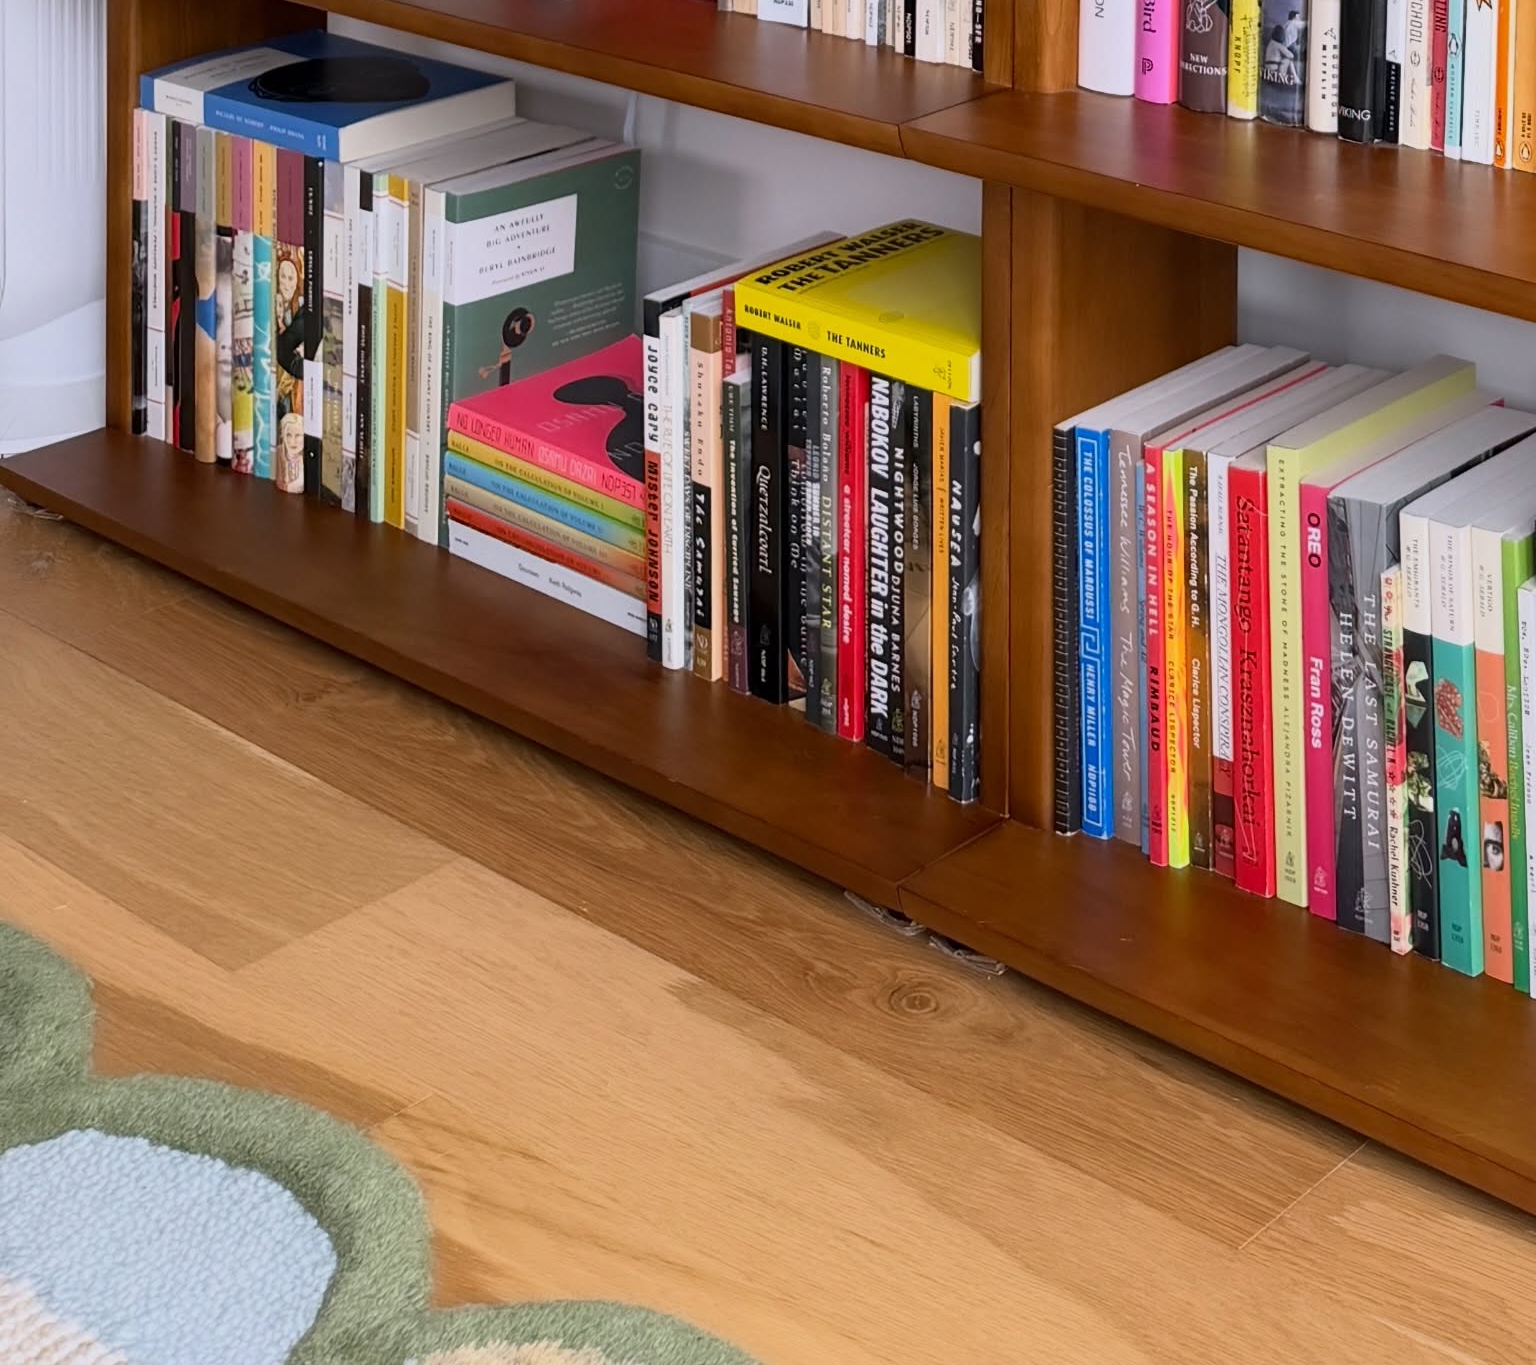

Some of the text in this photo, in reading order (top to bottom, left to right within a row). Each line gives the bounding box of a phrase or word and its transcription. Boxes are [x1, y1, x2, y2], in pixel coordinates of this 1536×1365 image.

[827, 331, 885, 358] THE TANNERS
[871, 376, 888, 593] NABOKOV LAUGHTER
[1083, 451, 1096, 618] THE COLOSSUS OF MAROUSSI
[1235, 496, 1260, 827] Satantango Krasznahorkai
[1307, 512, 1324, 748] OREO Fran Ross
[1362, 594, 1379, 849] THE LAST SAMURAI
